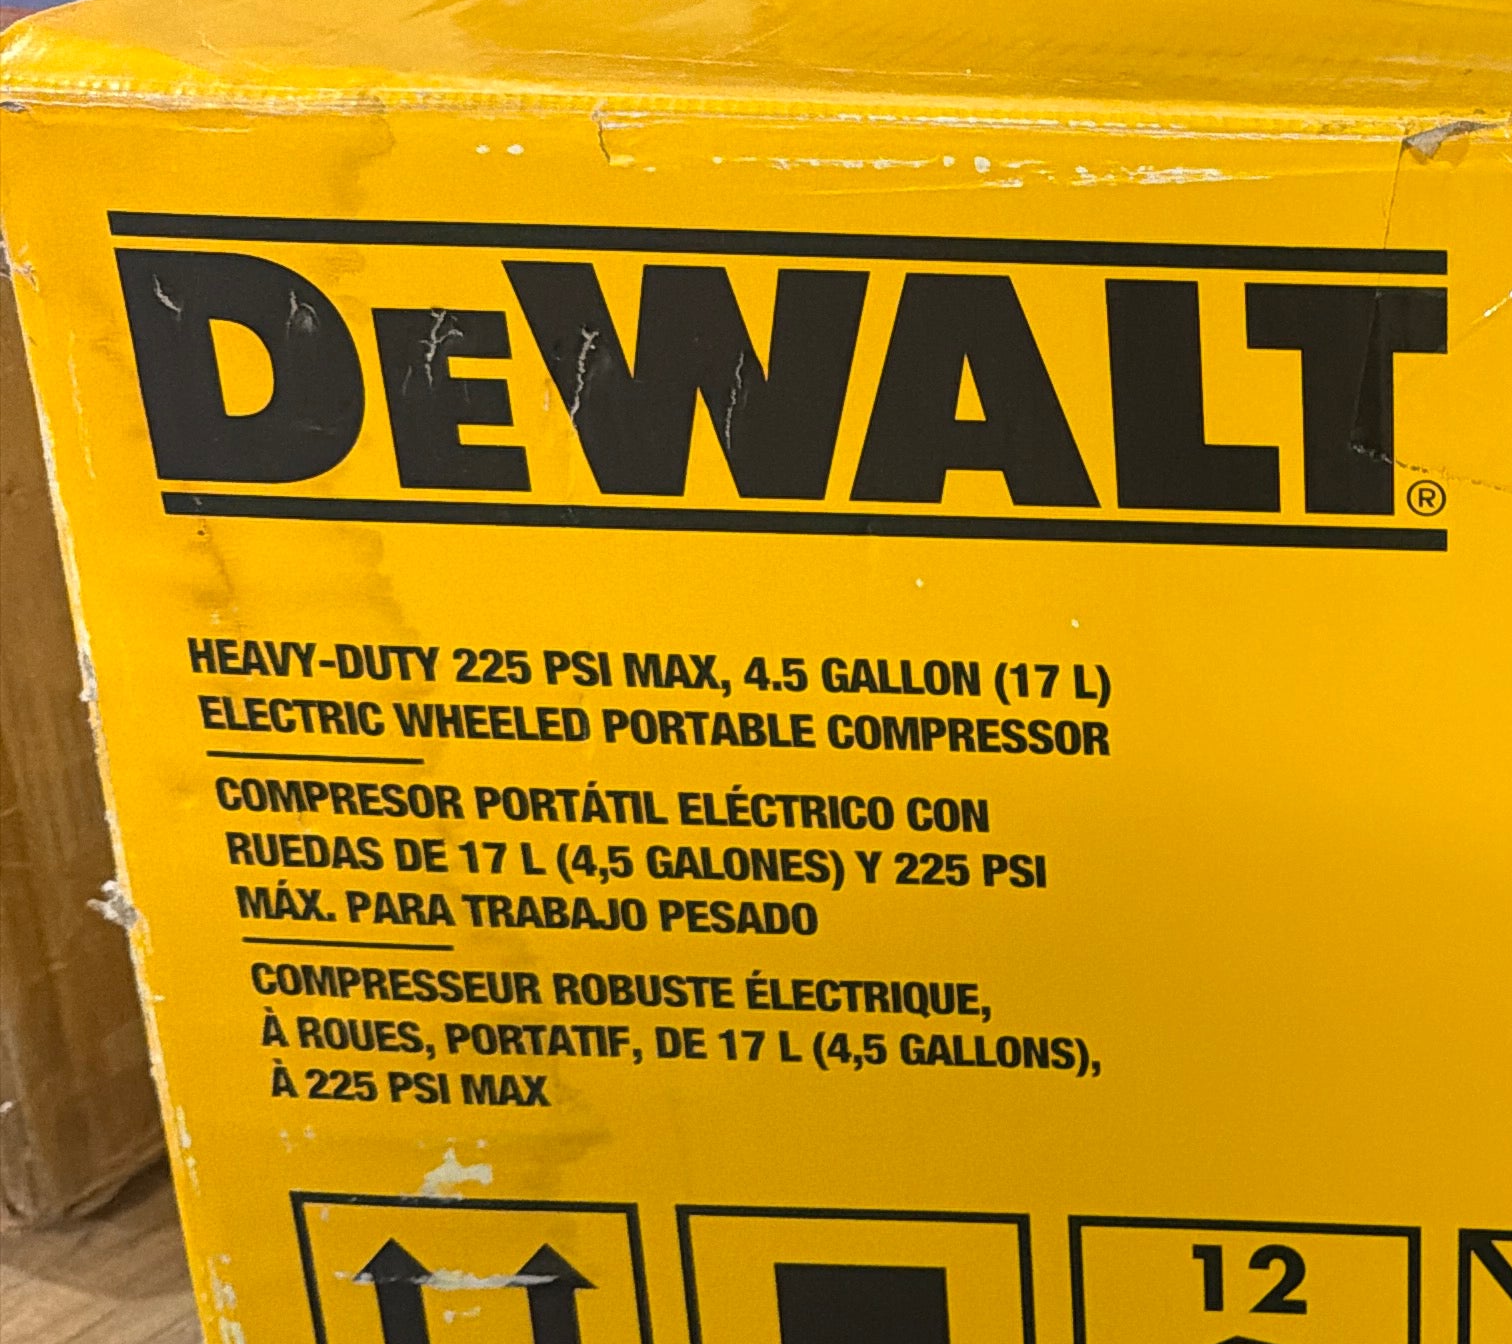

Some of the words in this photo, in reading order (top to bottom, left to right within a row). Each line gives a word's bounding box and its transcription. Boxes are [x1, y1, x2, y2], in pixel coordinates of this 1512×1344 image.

[187, 637, 440, 682] HEAVY-DUTY
[452, 648, 532, 685] 225
[544, 650, 612, 688] PSI
[624, 652, 732, 699] MAX,
[744, 657, 808, 692] 4.5
[821, 658, 981, 696] GALLON
[995, 662, 1060, 706] (17
[1074, 664, 1112, 709] L)
[198, 695, 385, 737] ELECTRIC
[393, 702, 591, 742] WHEELED
[603, 709, 816, 748] PORTABLE
[827, 714, 1111, 756] COMPRESSOR
[215, 776, 464, 819] COMPRESOR
[474, 781, 669, 826] PORTÁTIL
[678, 784, 895, 830] ELÉCTRICO
[906, 798, 990, 833] CON
[226, 832, 385, 871] RUEDAS
[394, 838, 449, 873] DE
[459, 841, 507, 874] 17
[521, 842, 547, 875] L
[556, 843, 634, 885] (4,5
[647, 845, 845, 891] GALONES)
[855, 851, 883, 884] Y
[895, 852, 971, 887] 225
[983, 853, 1047, 888] PSI
[235, 879, 337, 922] MÁX.
[346, 890, 456, 927] PARA
[461, 893, 647, 932] TRABAJO
[658, 900, 819, 936] PESADO
[251, 962, 543, 1004] COMPRESSEUR
[553, 972, 736, 1009] ROBUSTE
[745, 969, 992, 1023] ÉLECTRIQUE,
[261, 1006, 290, 1049] À
[296, 1015, 437, 1060] ROUES,
[445, 1023, 644, 1065] PORTATIF,
[655, 1026, 706, 1060] DE
[718, 1028, 766, 1062] 17
[779, 1030, 802, 1063] L
[812, 1031, 888, 1072] (4,5
[899, 1034, 1103, 1078] GALLONS),
[271, 1058, 299, 1099] À
[305, 1068, 379, 1103] 225
[388, 1072, 451, 1105] PSI
[461, 1075, 552, 1108] MAX
[1192, 1243, 1308, 1316] 12
